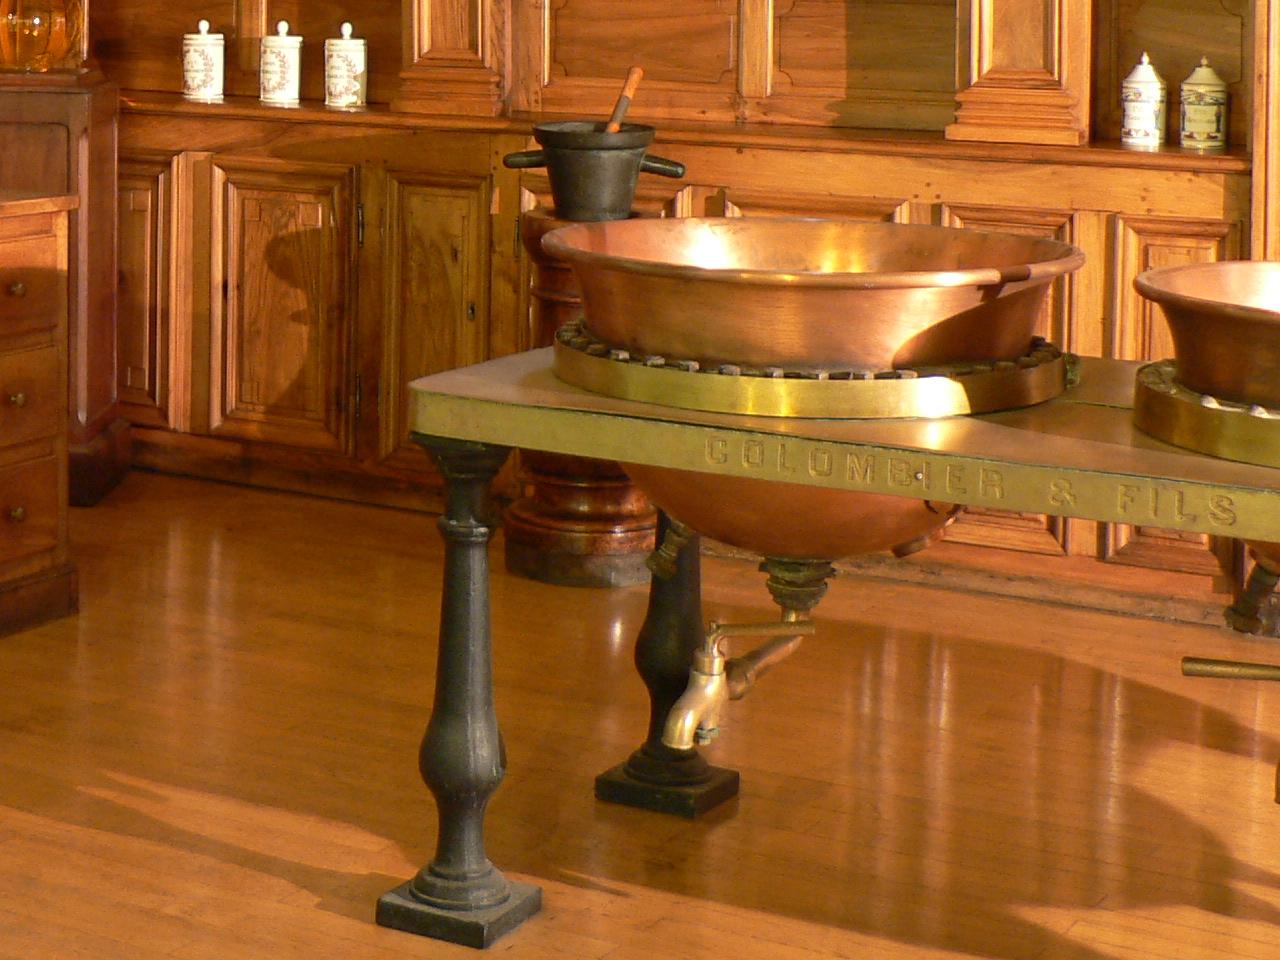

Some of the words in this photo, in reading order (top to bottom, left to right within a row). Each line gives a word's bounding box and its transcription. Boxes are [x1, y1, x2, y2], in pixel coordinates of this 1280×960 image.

[704, 438, 1005, 499] COLOMBIER
[1048, 478, 1077, 507] &
[1119, 482, 1238, 527] FILS
